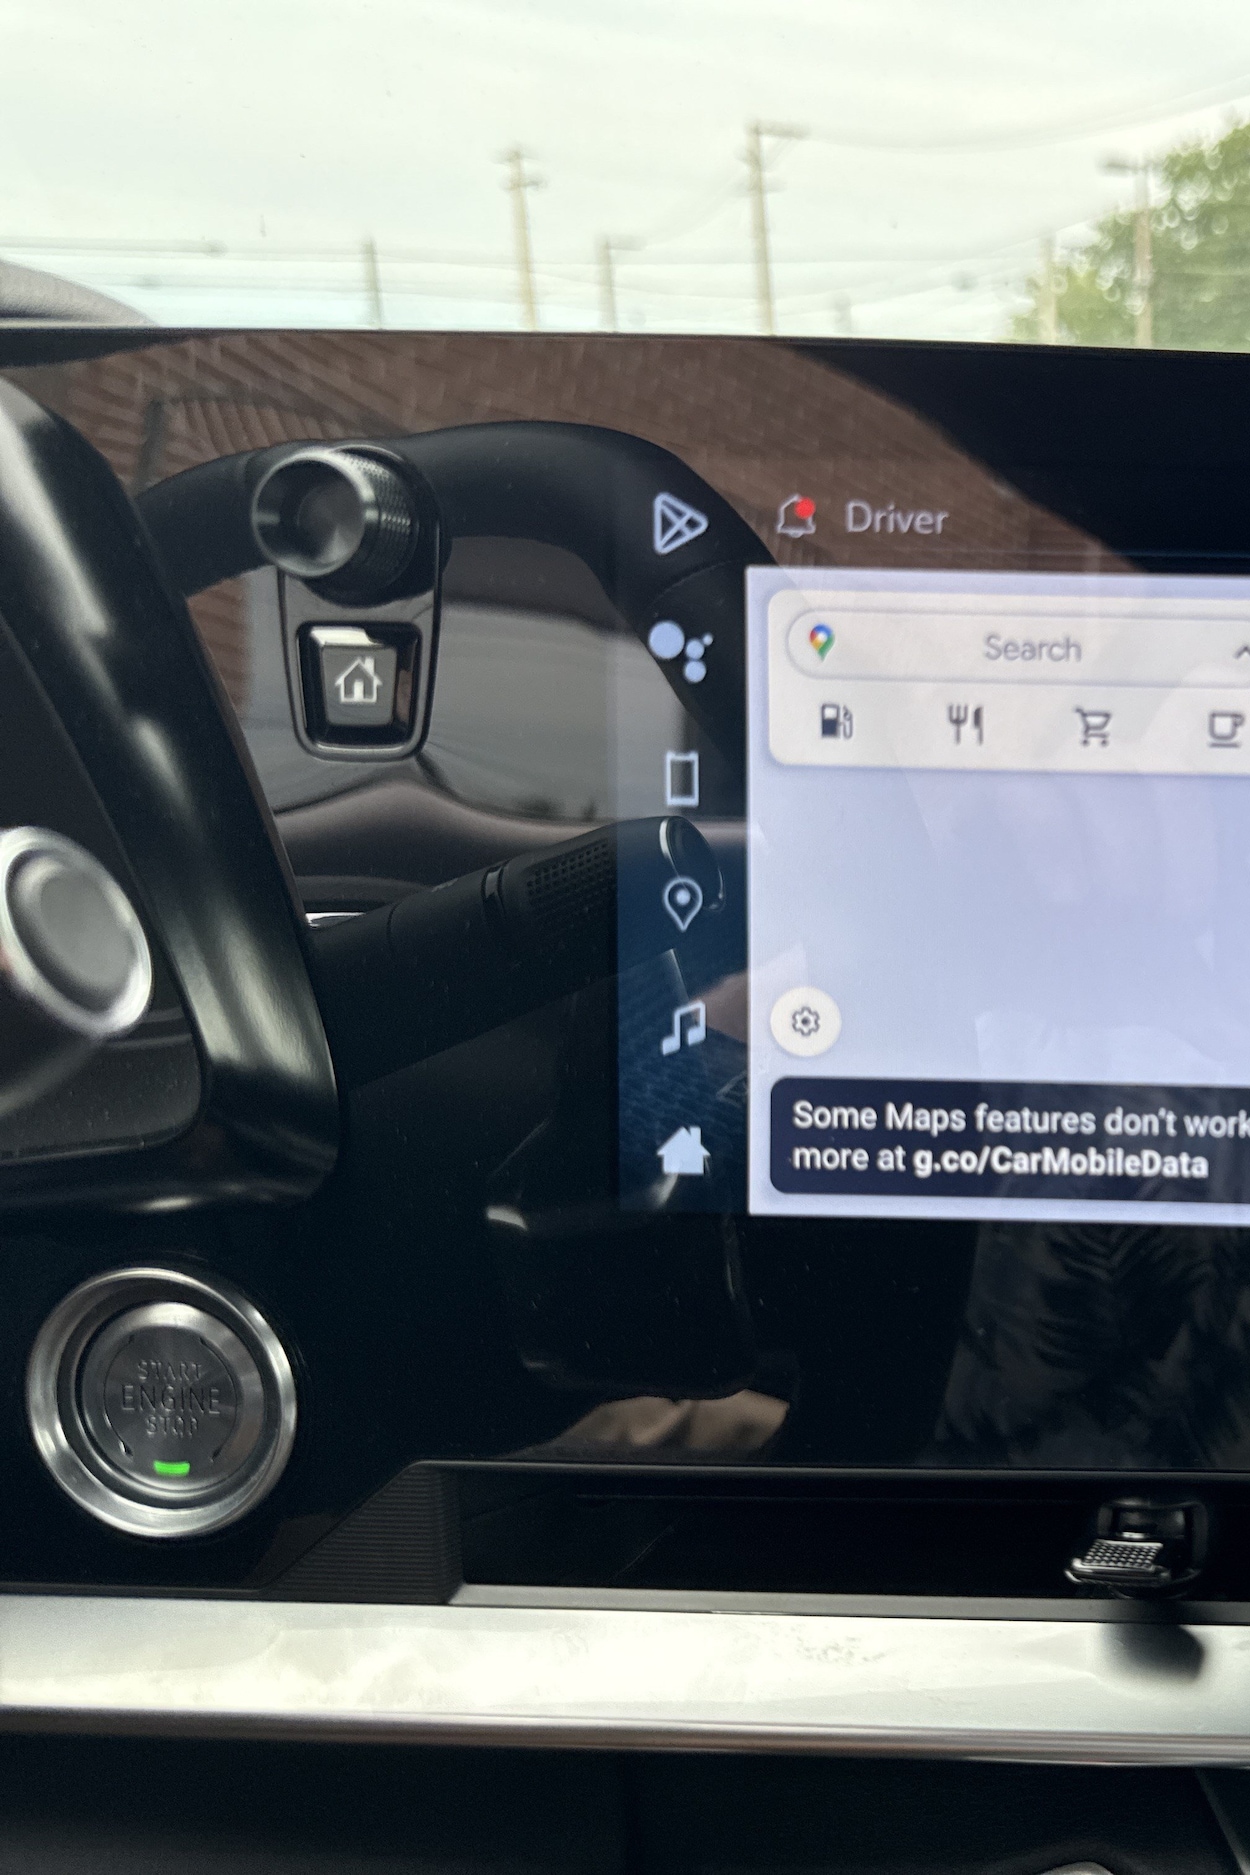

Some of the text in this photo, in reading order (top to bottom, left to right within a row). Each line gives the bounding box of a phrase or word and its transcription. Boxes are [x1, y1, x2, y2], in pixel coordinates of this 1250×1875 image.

[846, 500, 948, 534] Driver
[984, 632, 1083, 664] Search
[792, 1099, 878, 1131] Some
[885, 1102, 967, 1136] Maps
[975, 1104, 1096, 1135] features
[1103, 1107, 1178, 1138] don't
[792, 1145, 1210, 1179] more at g.co/CarMobileData
[137, 1359, 203, 1382] START
[122, 1385, 220, 1416] ENGINE
[146, 1416, 199, 1438] STOP
